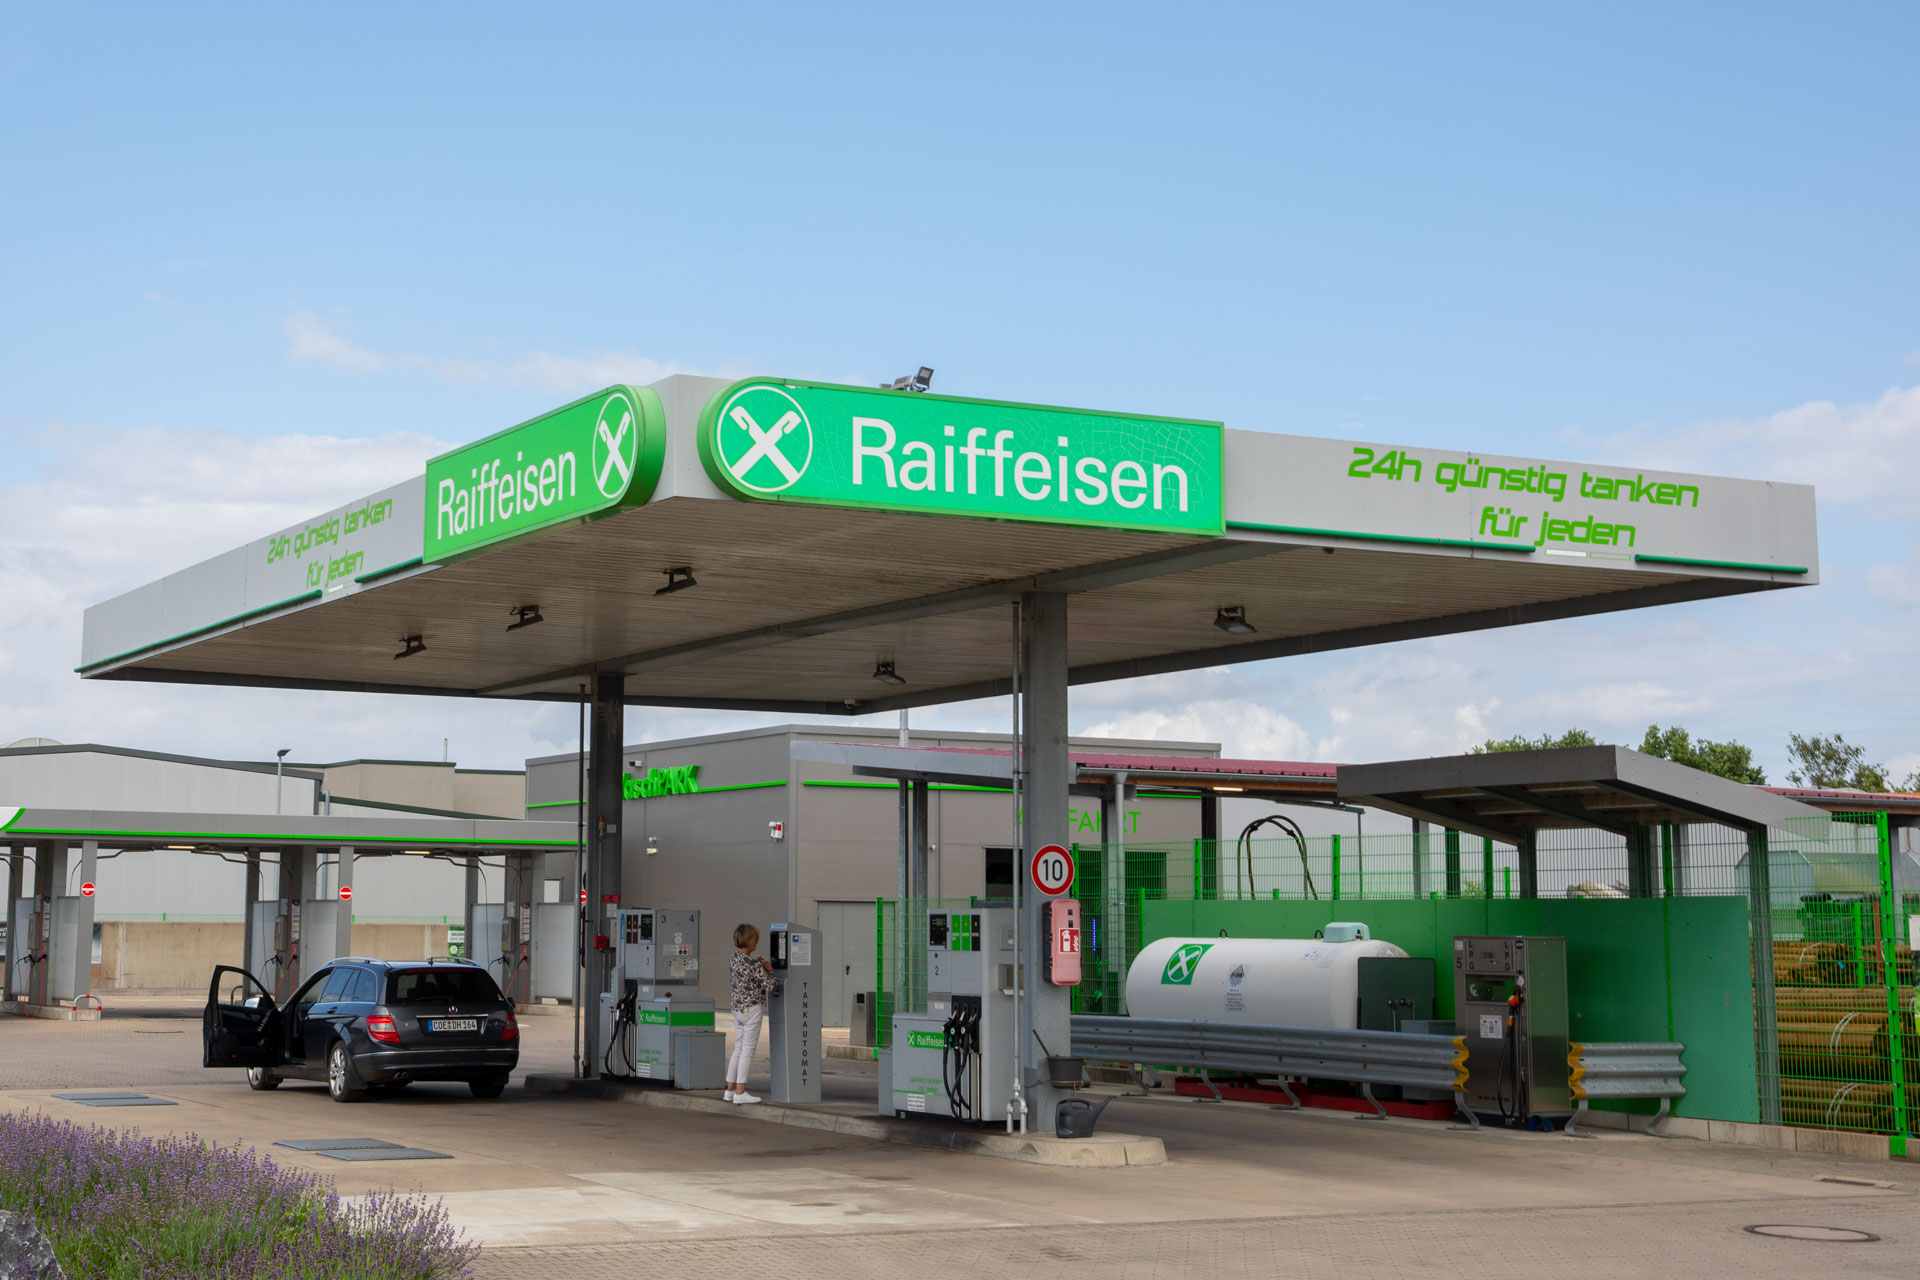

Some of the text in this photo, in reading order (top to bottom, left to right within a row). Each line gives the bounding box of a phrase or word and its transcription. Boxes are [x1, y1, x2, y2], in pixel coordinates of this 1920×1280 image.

[852, 416, 1188, 512] Raiffeisen
[1348, 447, 1699, 507] 24h günstig tanken
[437, 451, 576, 540] Raiffeisen
[267, 498, 392, 564] 24h günstig tanken
[1479, 506, 1636, 547] für jeden
[306, 550, 364, 589] für jeden
[622, 765, 700, 800] aschPARK
[1043, 859, 1063, 881] 10
[661, 914, 667, 923] 3
[689, 914, 694, 923] 4
[934, 965, 940, 976] 2
[1456, 957, 1463, 969] 5
[433, 1020, 476, 1030] COE DH 164
